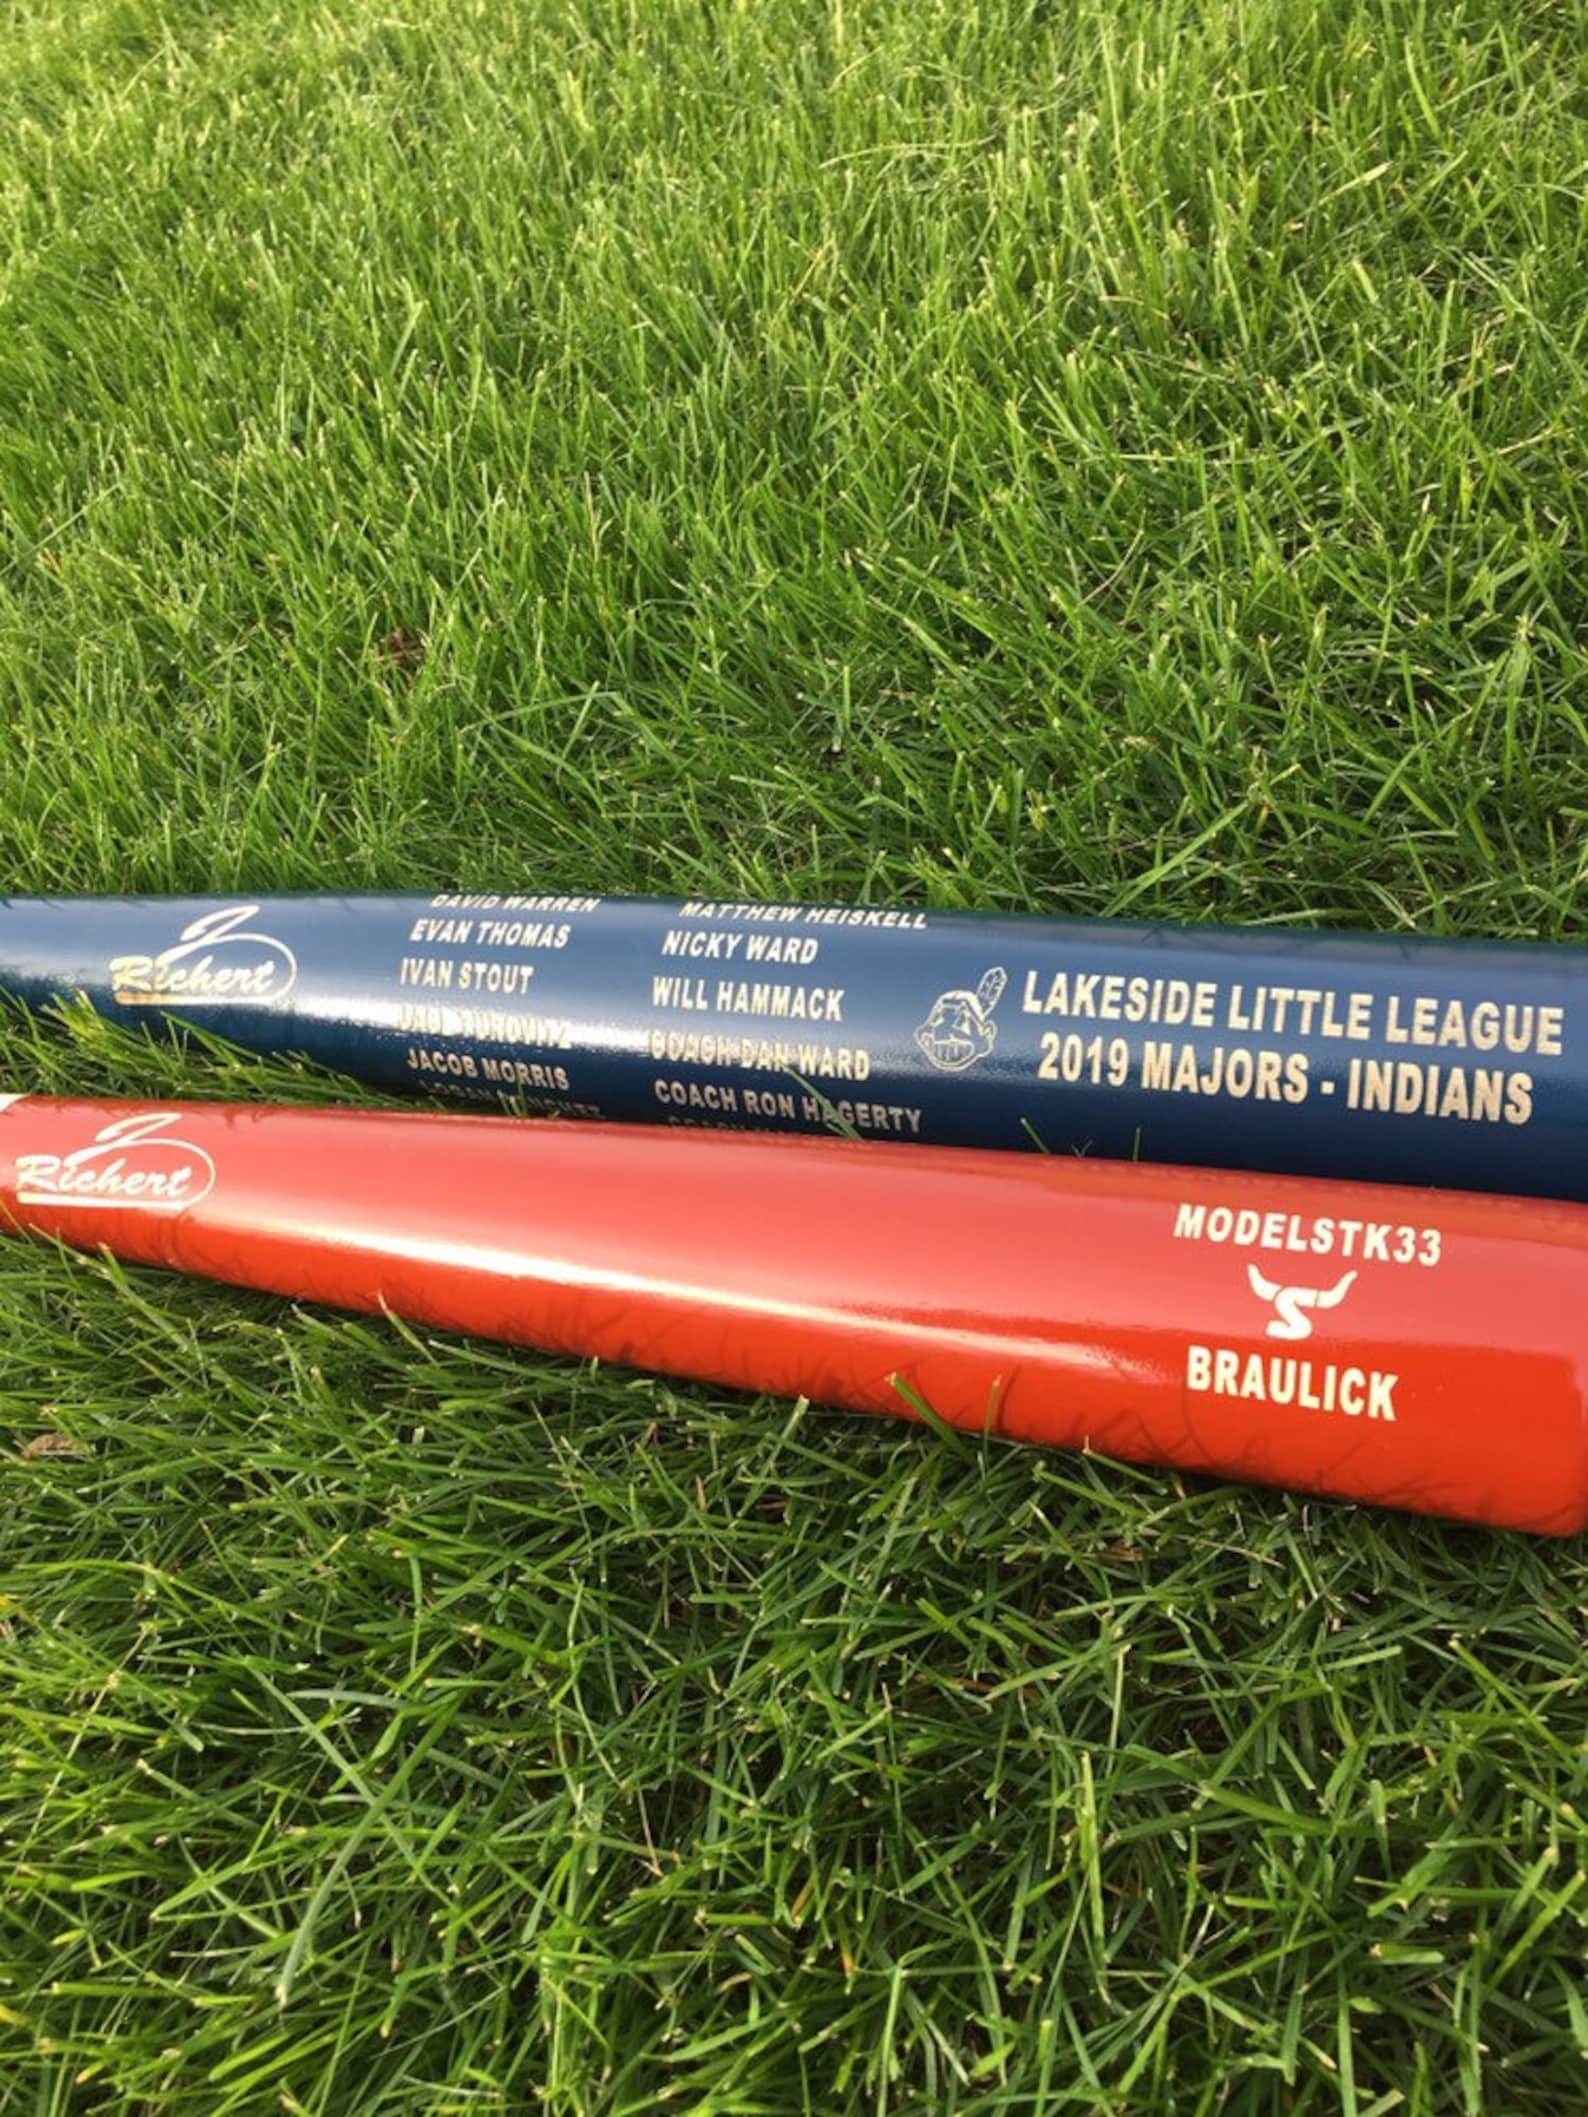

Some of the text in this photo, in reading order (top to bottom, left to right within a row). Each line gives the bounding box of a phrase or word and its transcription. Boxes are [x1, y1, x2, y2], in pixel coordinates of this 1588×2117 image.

[430, 894, 600, 913] DAVID WARREN
[679, 902, 928, 930] MATTHEW HEISKELL
[410, 919, 571, 948] EVAN THOMAS
[661, 930, 818, 965] NICKY WARD
[109, 955, 275, 991] Richert
[400, 957, 534, 994] IVAN STOUT
[652, 975, 845, 1022] WILL HAMMACK
[1022, 970, 1564, 1056] LAKESIDE LITTLE LEAGUE
[407, 1047, 571, 1091] JACOB MORRIS
[740, 1039, 789, 1073] DAN
[797, 1044, 871, 1082] WARD
[1038, 1032, 1129, 1087] 2019
[1141, 1041, 1309, 1104] MAJORS
[1347, 1058, 1534, 1126] INDIANS
[654, 1079, 738, 1112] COACH
[743, 1089, 796, 1120] RON
[15, 1154, 193, 1197] Richert
[1173, 1202, 1442, 1268] MODELSTK33
[1186, 1344, 1400, 1422] BRAULICK
